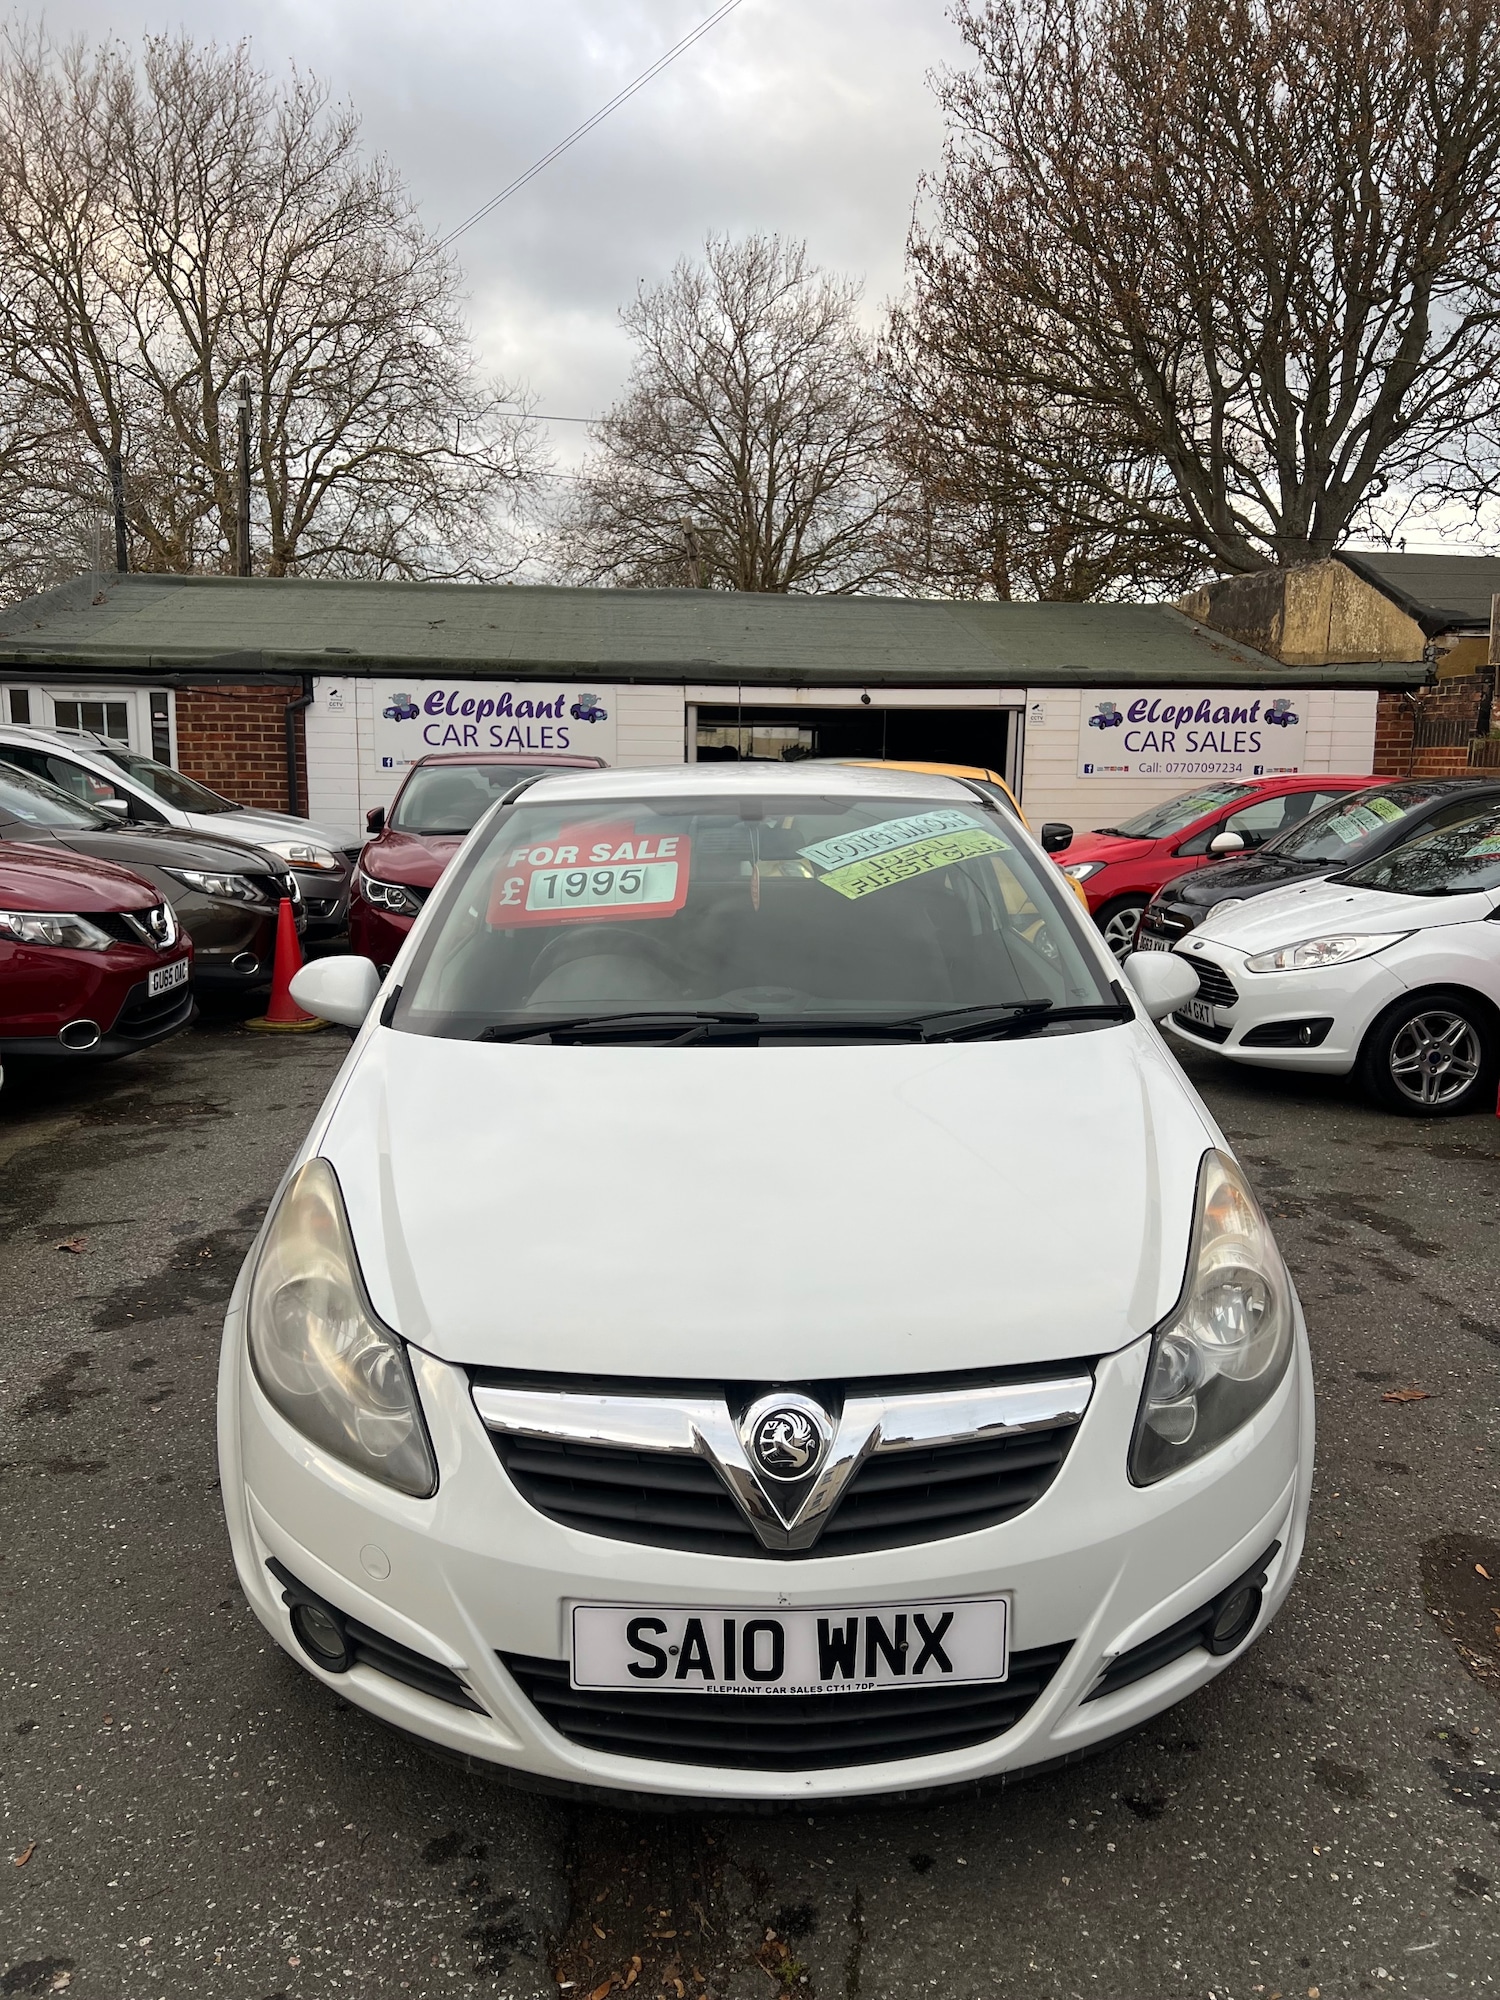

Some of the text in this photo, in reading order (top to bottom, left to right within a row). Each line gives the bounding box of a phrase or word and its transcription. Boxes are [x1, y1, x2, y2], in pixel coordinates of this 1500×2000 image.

[424, 690, 566, 723] Elephant
[1127, 698, 1261, 729] Elephant
[423, 724, 570, 748] CAR SALES
[1124, 731, 1262, 752] CAR SALES
[1139, 762, 1162, 773] Call:
[1166, 762, 1242, 773] 07707097234
[507, 837, 680, 868] FOR SALE
[807, 829, 896, 864] LONG
[860, 840, 957, 871] IDEAL
[841, 839, 1005, 894] FIRST CAR
[500, 869, 642, 906] £ 1995
[154, 967, 173, 990] GU65
[1194, 1002, 1210, 1022] GXT
[816, 1612, 954, 1680] WNX
[706, 1682, 875, 1694] ELEPHANT CAR SALES CT11 7DP
